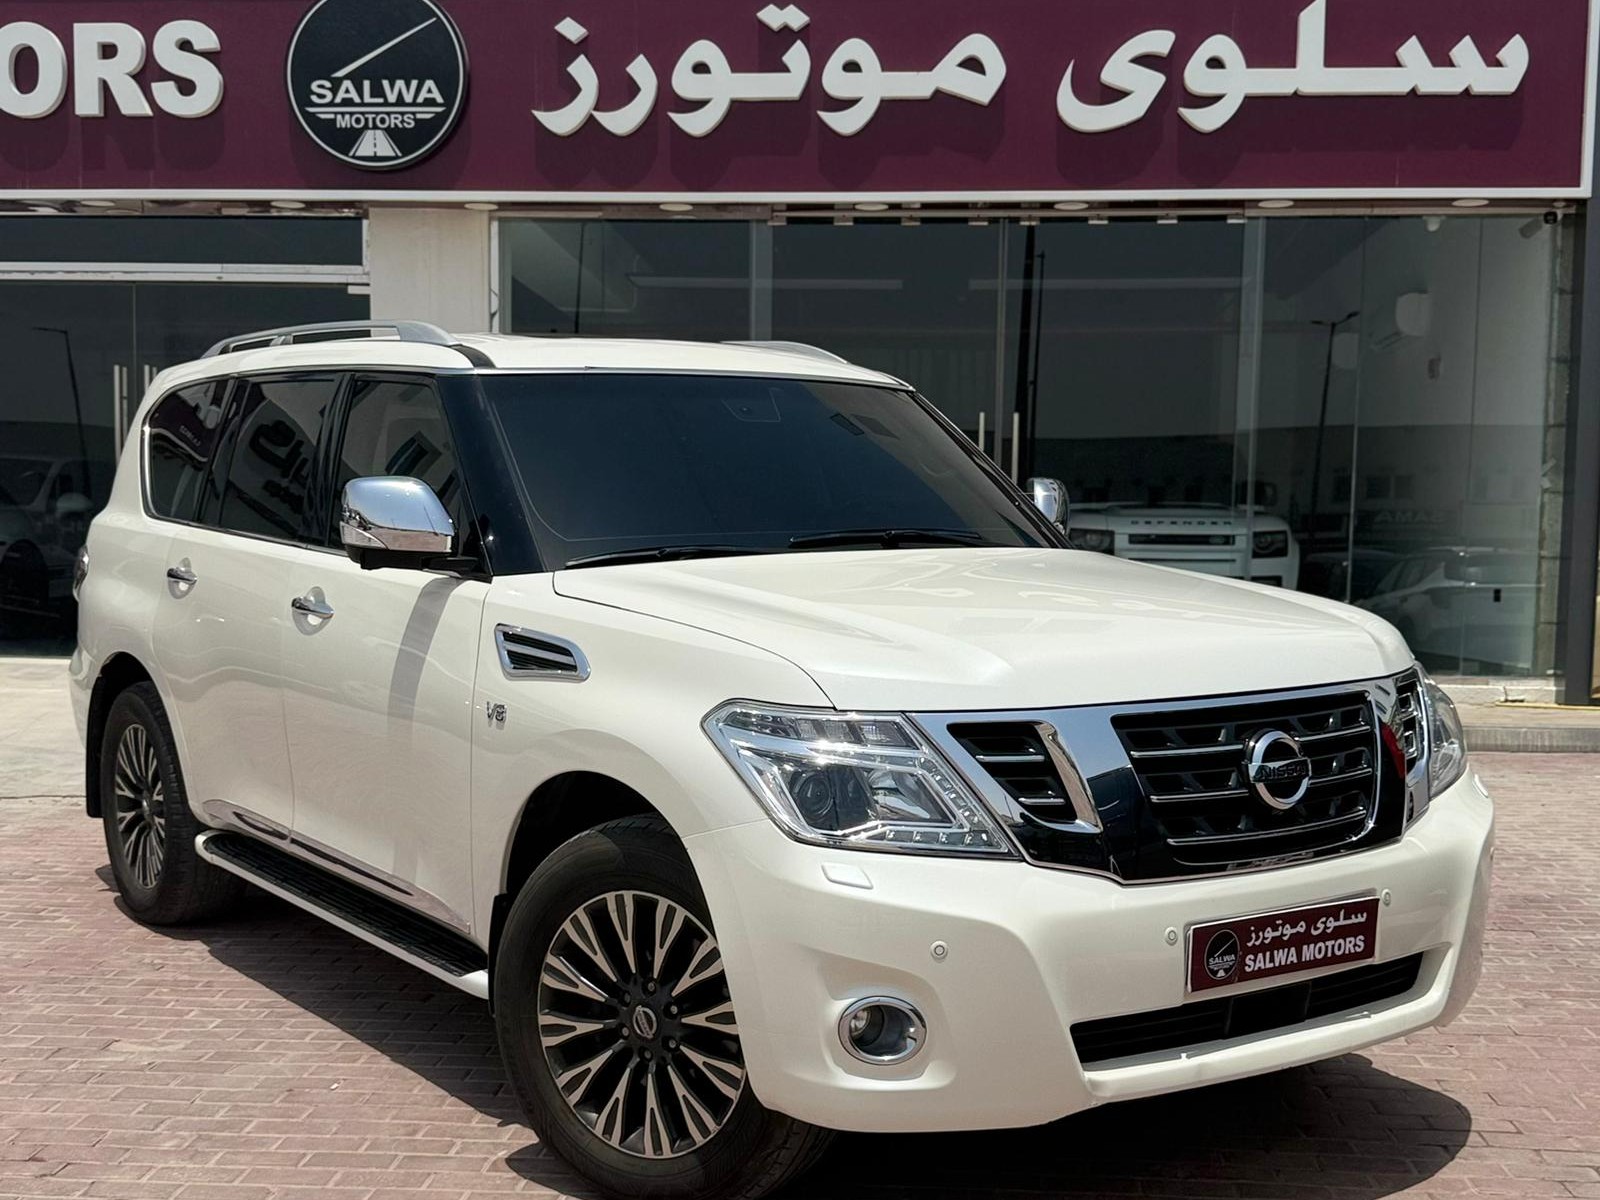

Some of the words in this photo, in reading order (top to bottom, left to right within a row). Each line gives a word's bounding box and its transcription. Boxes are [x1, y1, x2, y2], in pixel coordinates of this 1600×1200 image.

[531, 3, 1007, 138] موتورز
[1056, 0, 1530, 134] سلوى
[310, 79, 445, 104] SALWA
[335, 113, 416, 129] MOTORS
[486, 701, 507, 722] V8
[1245, 918, 1307, 948] موتورز
[1310, 908, 1368, 936] سلوى
[1208, 954, 1236, 965] SALWA
[1244, 946, 1298, 973] SALWA
[1301, 935, 1366, 963] MOTORS
